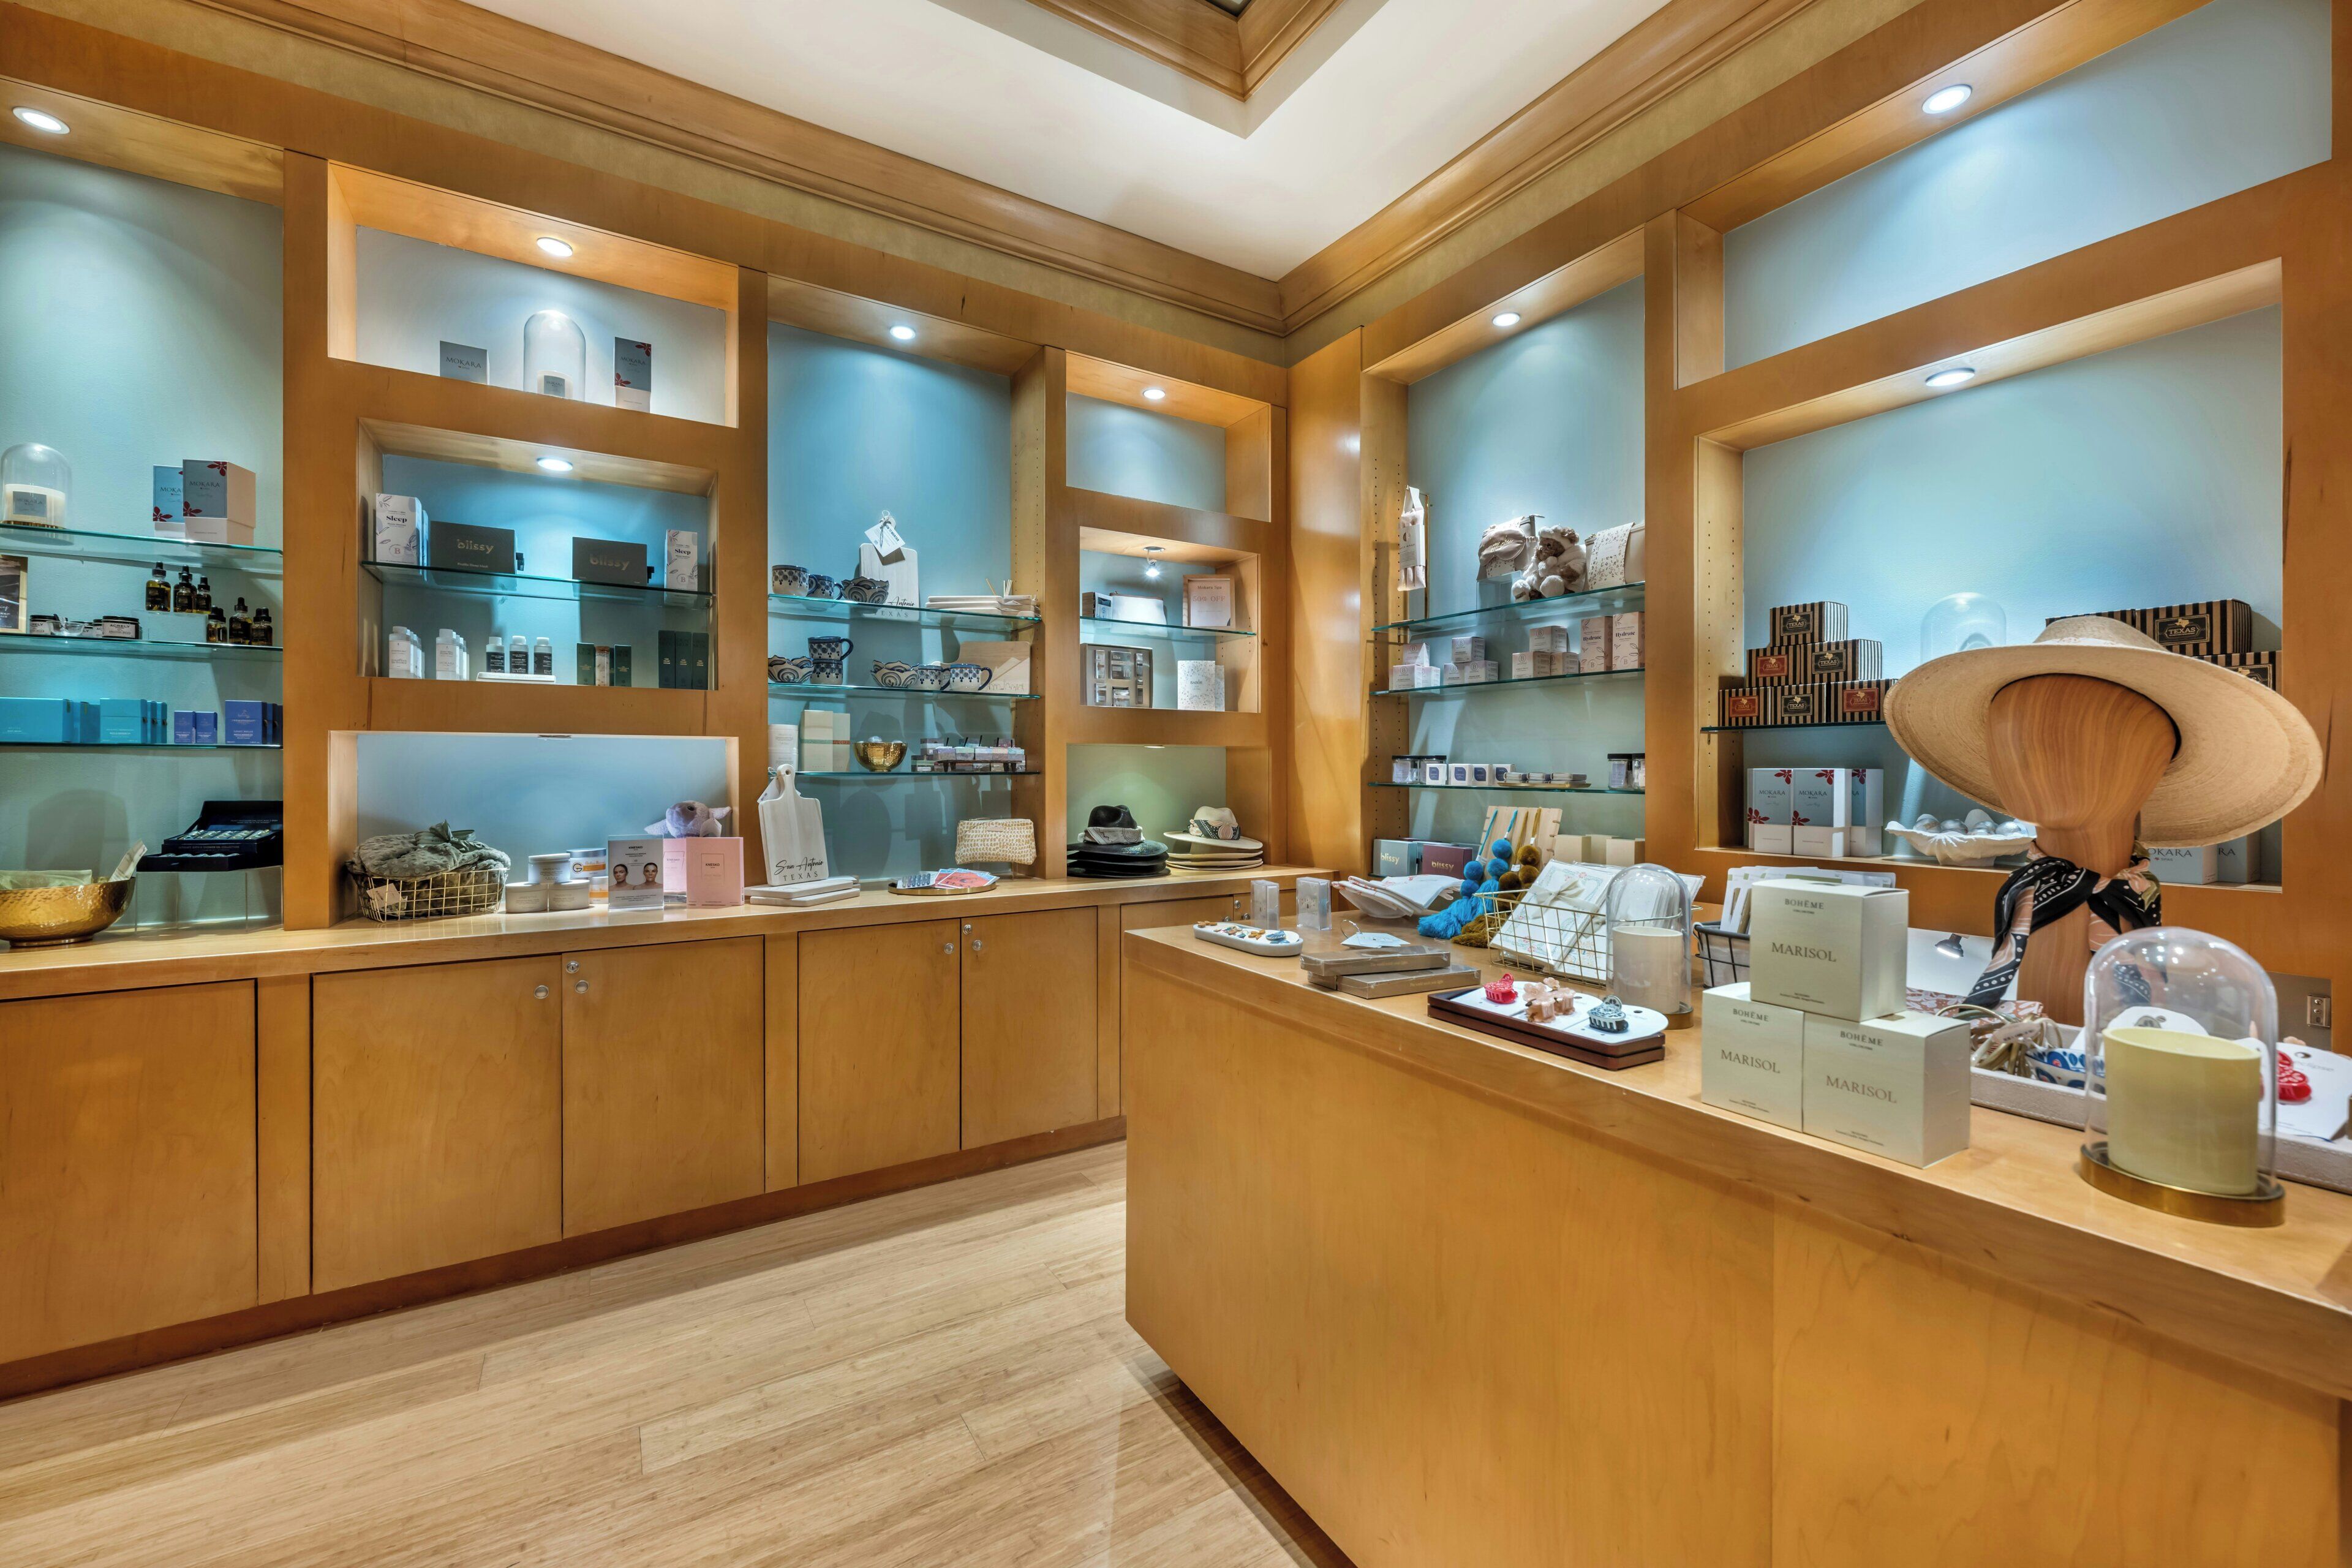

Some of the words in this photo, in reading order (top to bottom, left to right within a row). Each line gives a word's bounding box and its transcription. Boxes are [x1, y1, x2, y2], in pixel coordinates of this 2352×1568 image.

[446, 356, 481, 368] MOKARA
[620, 356, 646, 365] MOKARA
[457, 539, 494, 554] blissy
[888, 596, 915, 607] Antonio
[1381, 852, 1400, 865] blissy
[2147, 848, 2193, 858] OKARA
[774, 859, 794, 875] San
[796, 857, 824, 872] Antonio
[1431, 861, 1454, 871] blissy
[783, 871, 818, 881] TEXAS
[1771, 942, 1837, 962] MARISOL
[1721, 1049, 1781, 1074] MARISOL
[1826, 1075, 1897, 1103] MARISOL
